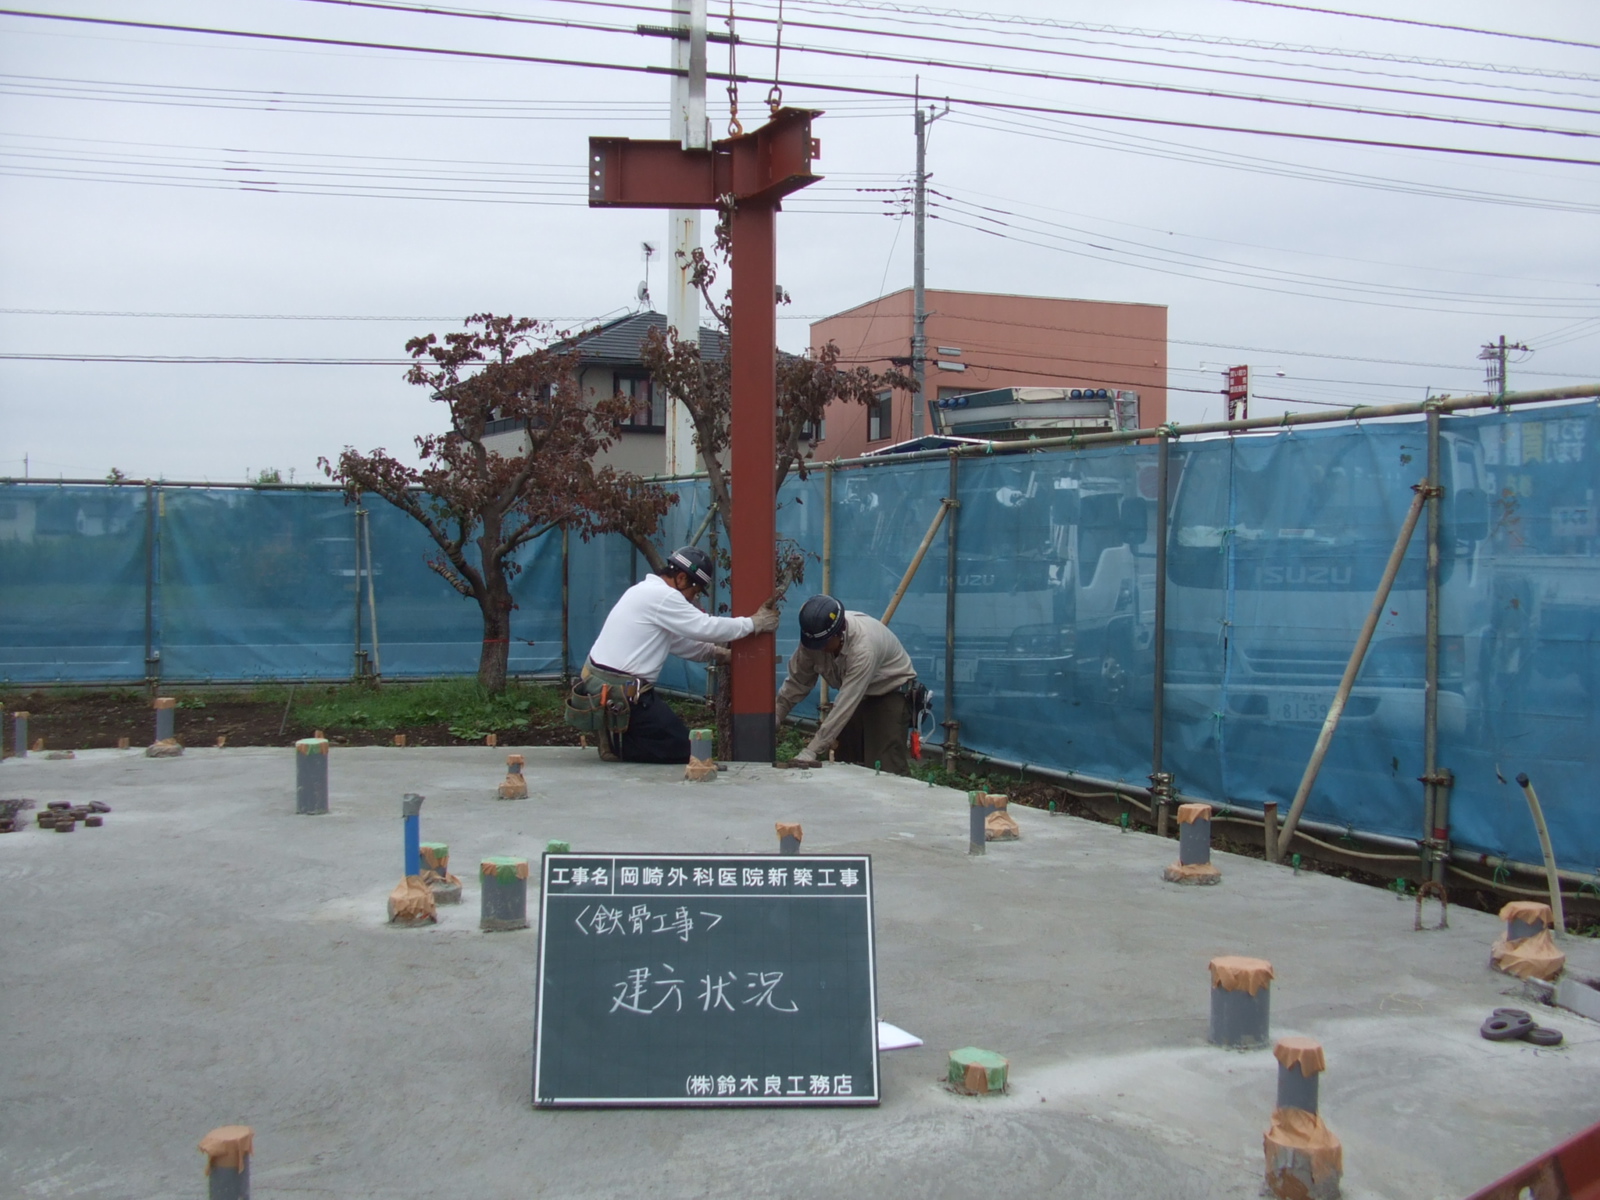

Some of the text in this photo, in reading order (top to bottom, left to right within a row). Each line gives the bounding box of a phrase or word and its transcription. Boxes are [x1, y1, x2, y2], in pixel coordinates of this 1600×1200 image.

[939, 574, 996, 587] IUZU
[1255, 566, 1352, 584] ISUZU
[551, 867, 860, 888] 工事名 岡崎外科医院新築工事
[609, 963, 800, 1013] 建方状況
